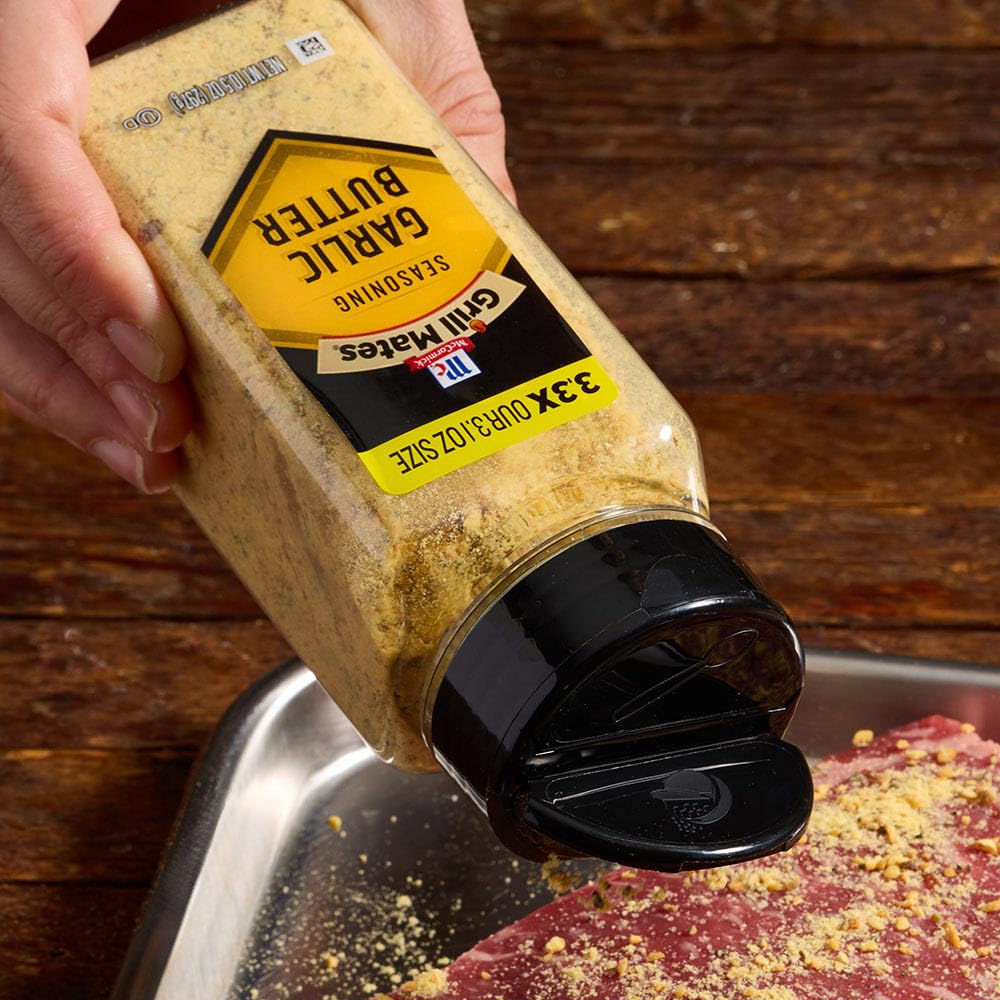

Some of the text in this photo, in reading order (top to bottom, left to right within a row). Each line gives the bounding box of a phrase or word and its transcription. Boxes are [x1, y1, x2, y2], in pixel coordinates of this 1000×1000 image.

[246, 63, 268, 86] WT
[257, 55, 288, 78] NET
[168, 85, 211, 117] (297g)
[202, 80, 226, 101] OZ
[252, 164, 410, 246] BUTTER
[287, 206, 429, 284] GARLIC
[333, 255, 450, 312] SEASONING
[340, 288, 500, 361] Grill Mates
[414, 337, 469, 368] McCormick
[389, 371, 600, 474] 3.3X OUR 3.1 OZ SIZE
